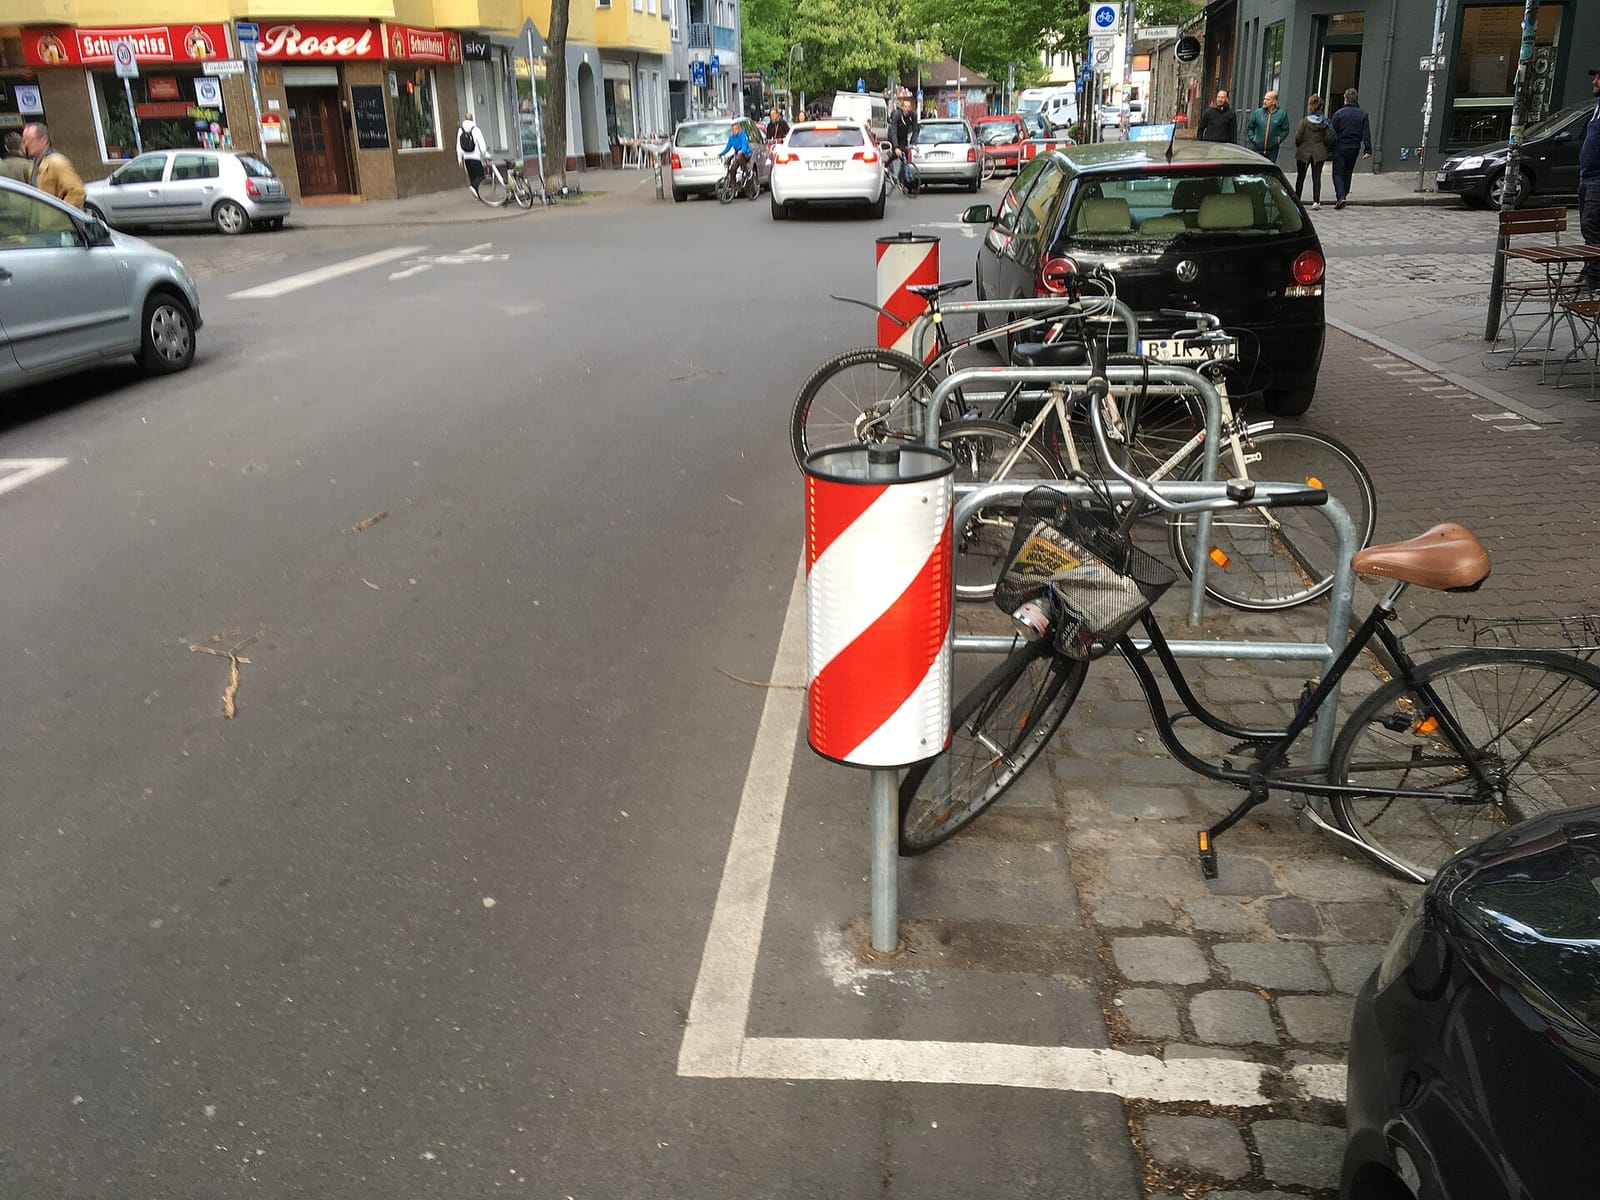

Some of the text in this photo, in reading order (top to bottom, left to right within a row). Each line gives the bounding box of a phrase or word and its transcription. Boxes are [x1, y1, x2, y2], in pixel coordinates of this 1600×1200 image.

[83, 34, 166, 56] Schheiss
[256, 24, 372, 56] Rosel
[465, 41, 485, 56] sky
[1149, 343, 1159, 357] B
